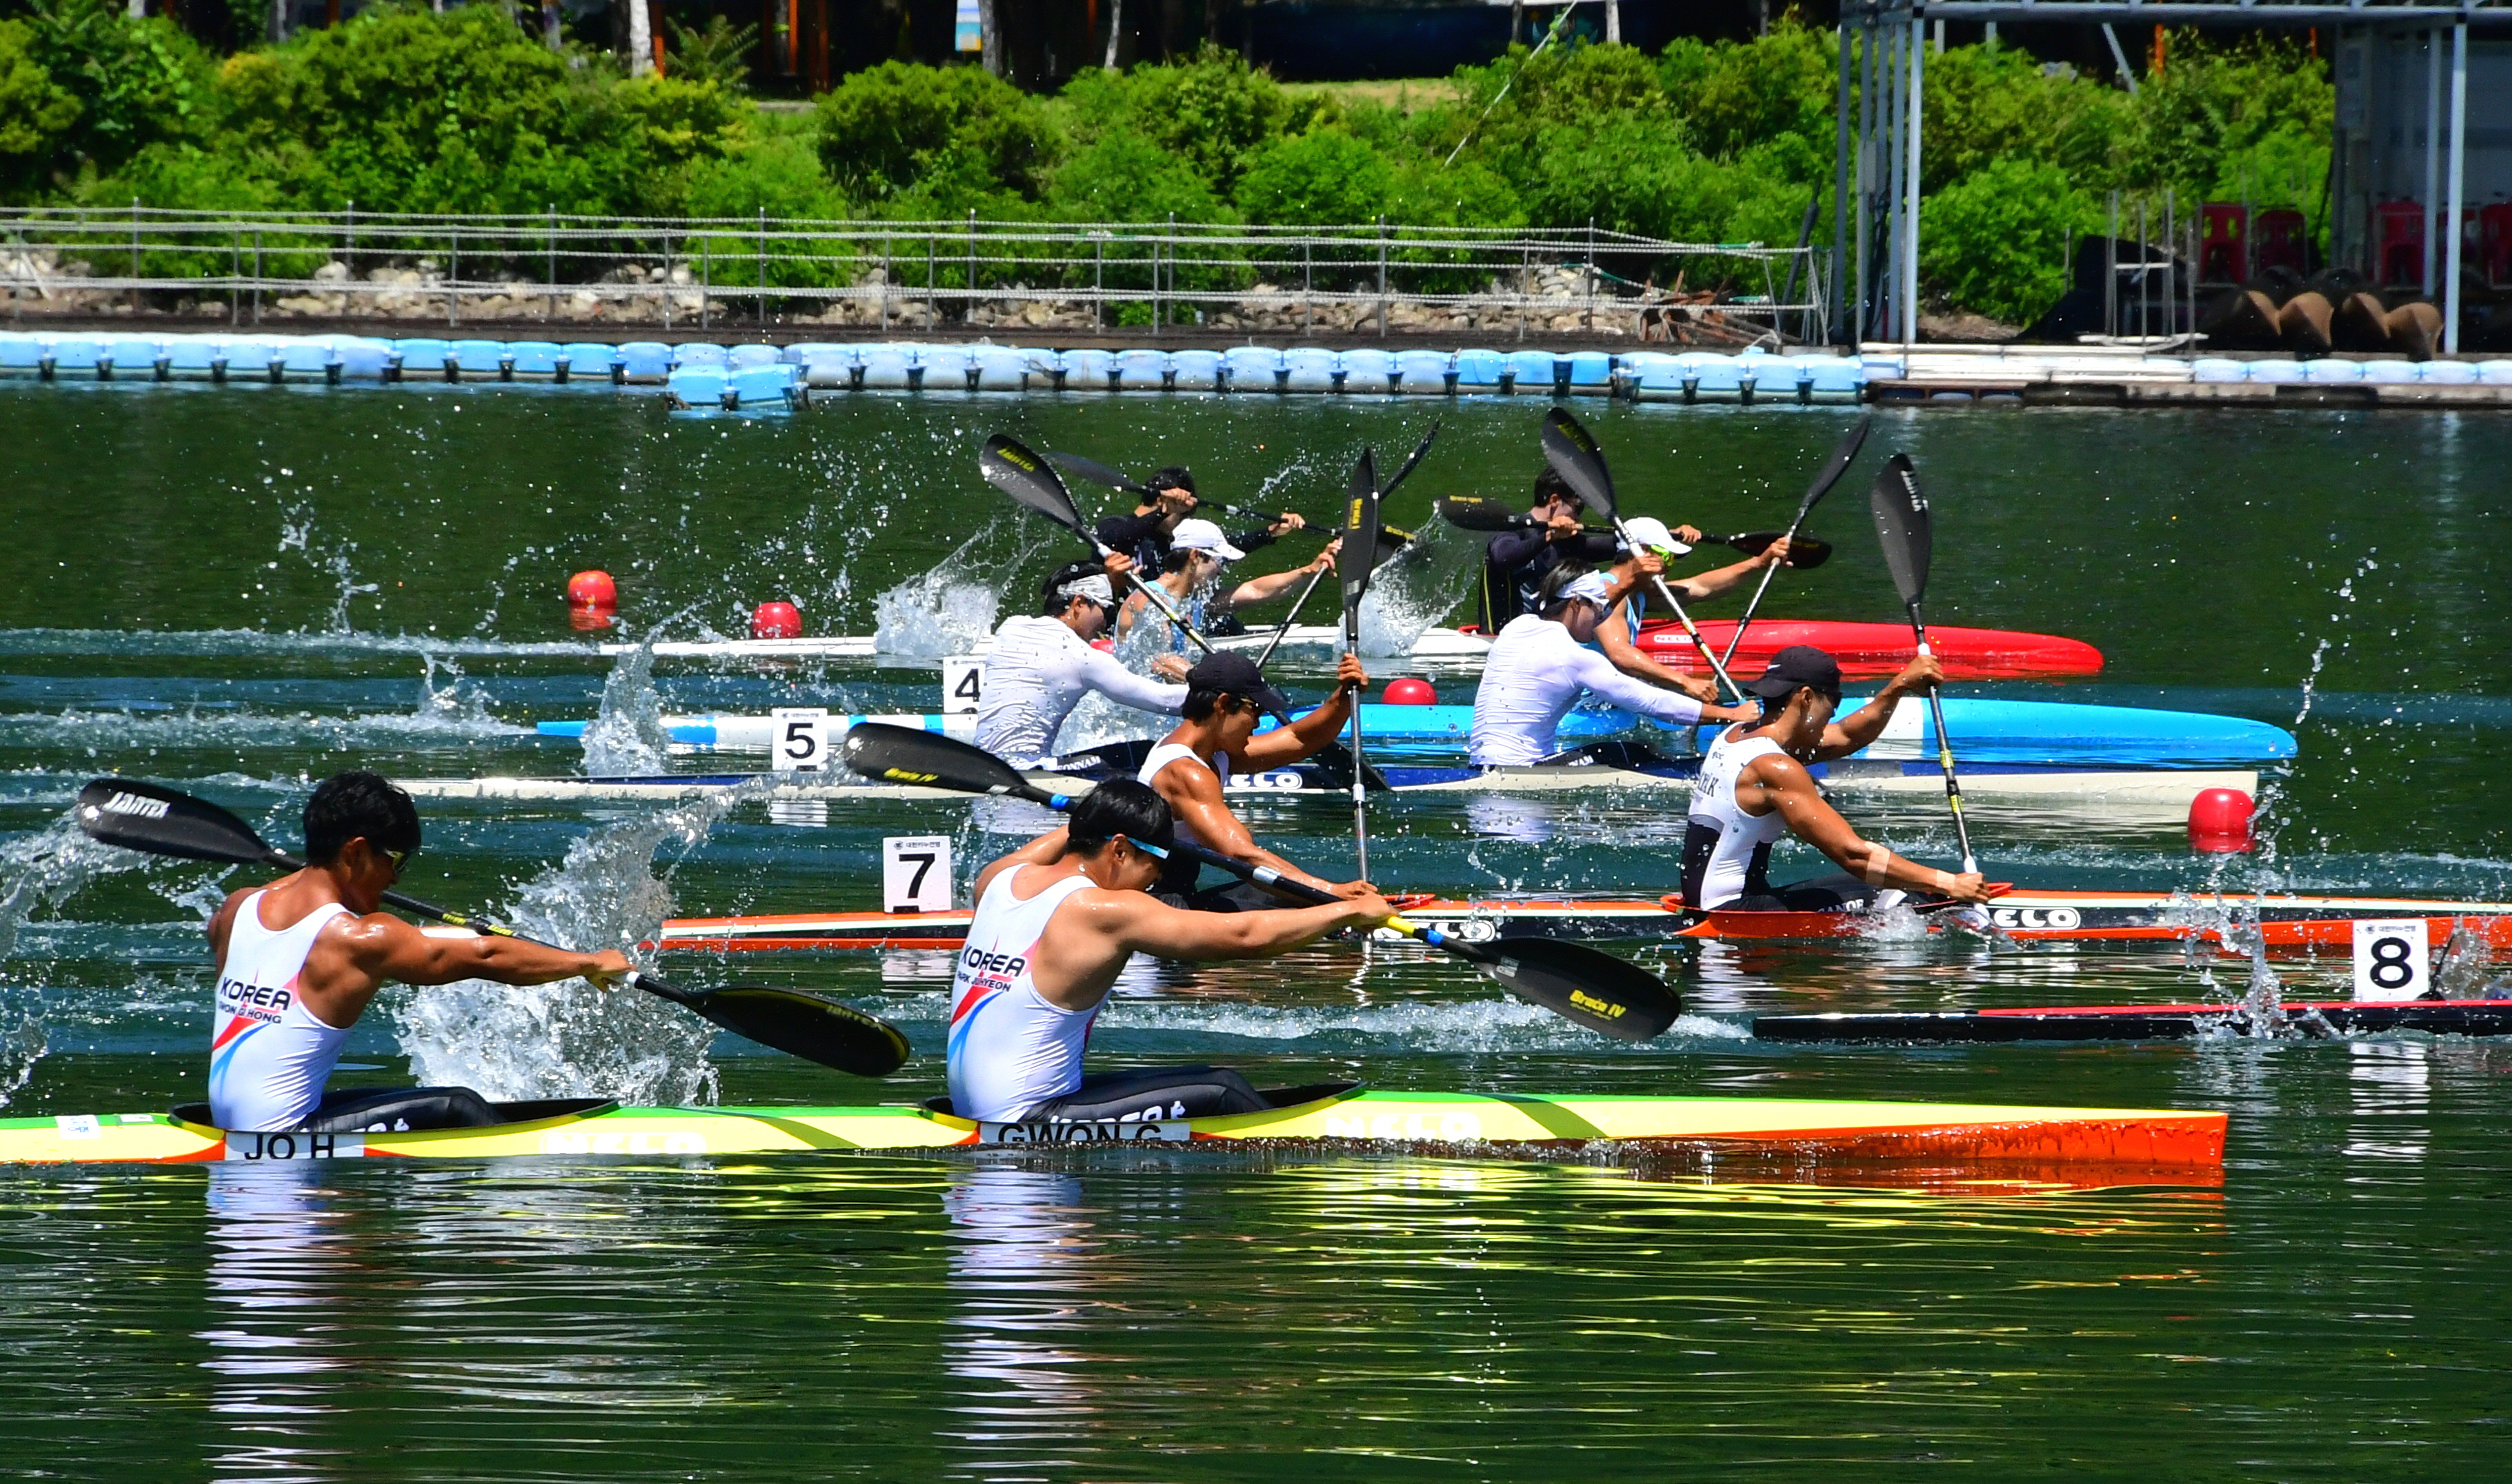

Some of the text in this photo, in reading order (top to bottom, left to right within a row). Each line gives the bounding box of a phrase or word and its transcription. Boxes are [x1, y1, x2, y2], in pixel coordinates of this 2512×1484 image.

[955, 668, 981, 702] 4
[785, 722, 815, 759] 5
[1230, 774, 1300, 788] ELO
[899, 853, 935, 899] 7
[1993, 909, 2077, 928] ELO
[961, 944, 1026, 977] KOREA
[2370, 936, 2413, 989] 8
[220, 976, 291, 1011] KOREA
[247, 1008, 282, 1024] HONG
[1608, 1003, 1626, 1018] IV
[998, 1124, 1121, 1142] GWON
[1326, 1115, 1479, 1142] NELO
[244, 1134, 335, 1160] JO H
